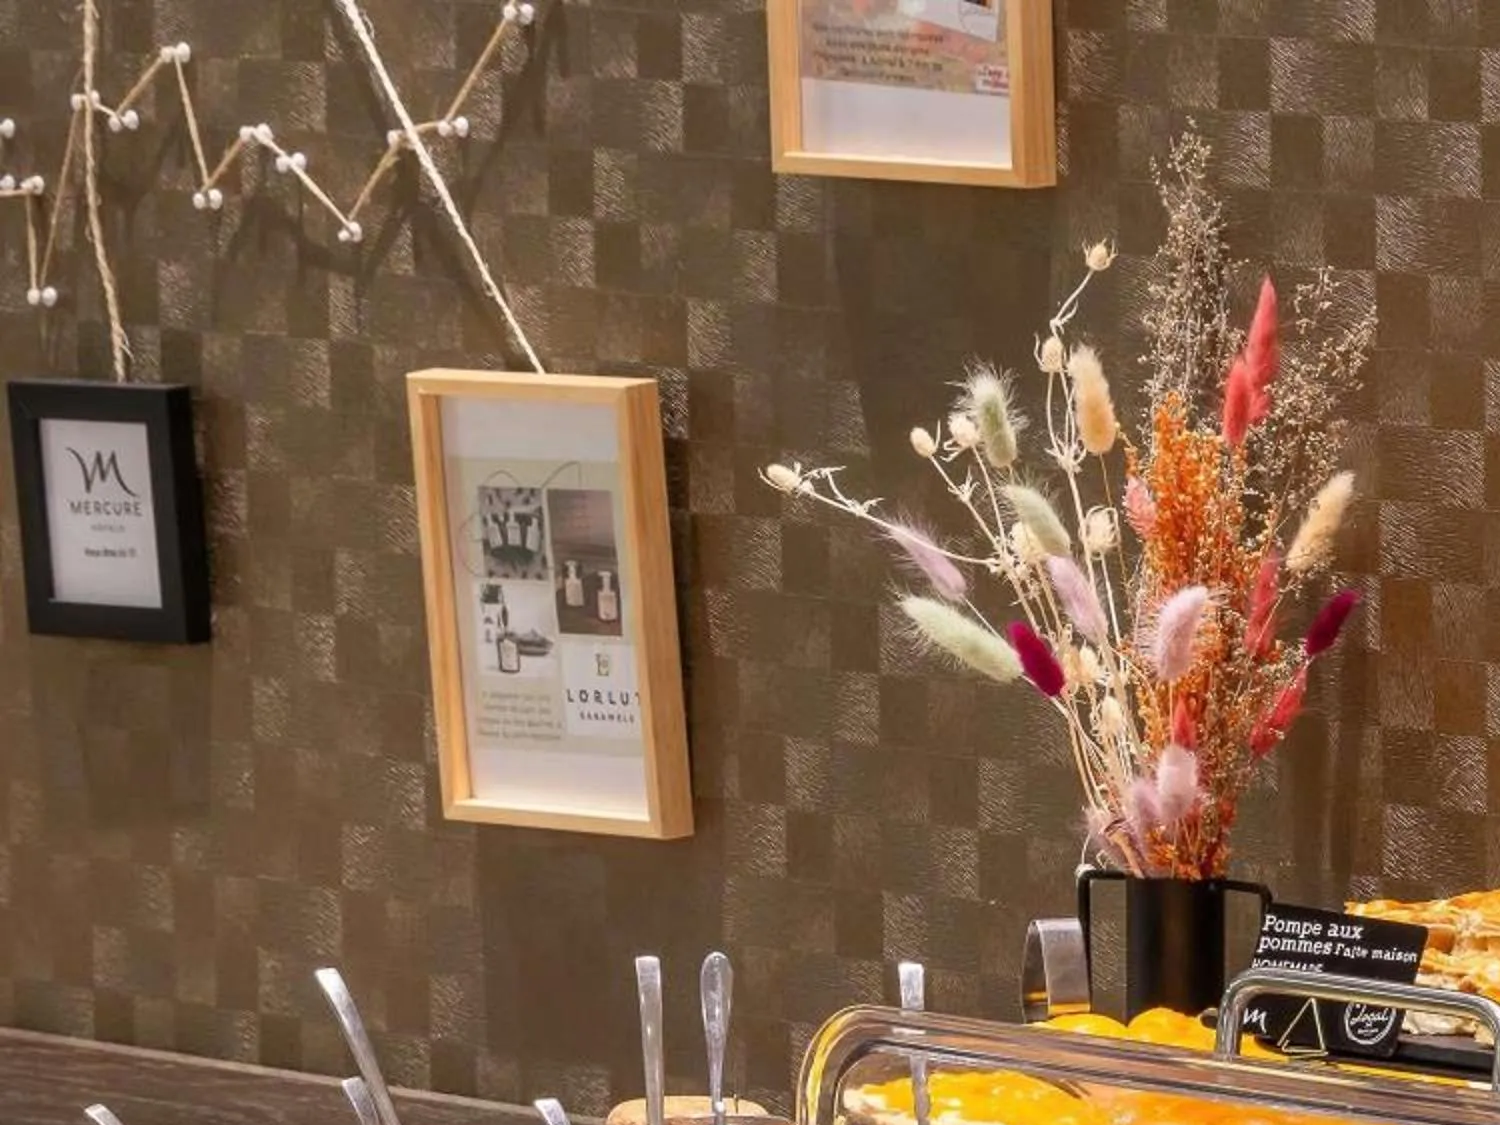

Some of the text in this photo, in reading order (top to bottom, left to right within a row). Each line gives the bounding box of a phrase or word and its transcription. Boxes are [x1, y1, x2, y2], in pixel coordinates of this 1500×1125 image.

[69, 500, 143, 517] MERCURE
[1262, 914, 1364, 940] Pompe aux
[1257, 935, 1333, 956] pommes
[1371, 949, 1418, 964] maison
